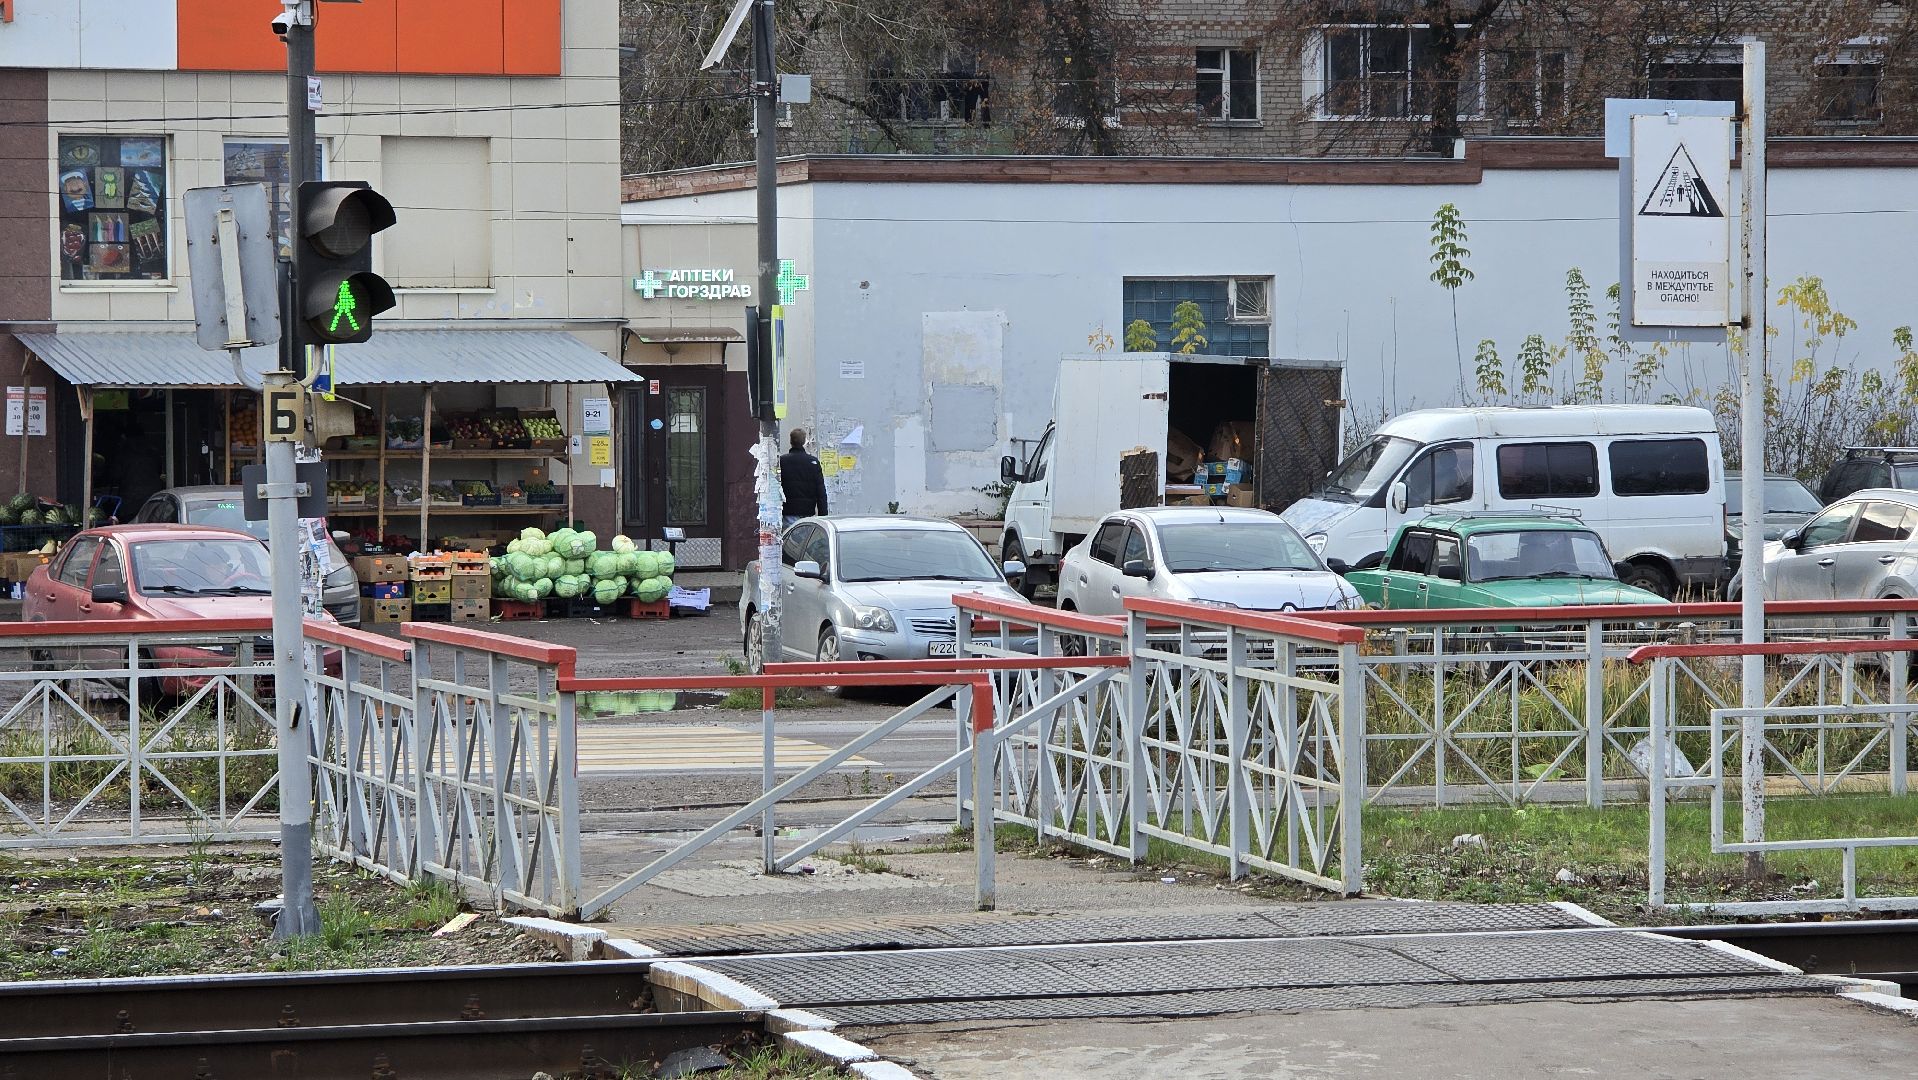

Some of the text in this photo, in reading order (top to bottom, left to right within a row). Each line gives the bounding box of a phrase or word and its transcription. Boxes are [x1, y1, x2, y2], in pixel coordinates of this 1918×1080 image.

[669, 269, 734, 282] АПТЕКИ
[1651, 270, 1709, 281] НАХОДИТЬСЯ
[668, 284, 752, 299] ГОРЗДРАВ
[1647, 281, 1714, 292] В МЕЖДУПУТЬЕ
[1660, 293, 1700, 303] ОПАСНО!
[270, 391, 297, 435] Б
[585, 410, 601, 418] 9-21
